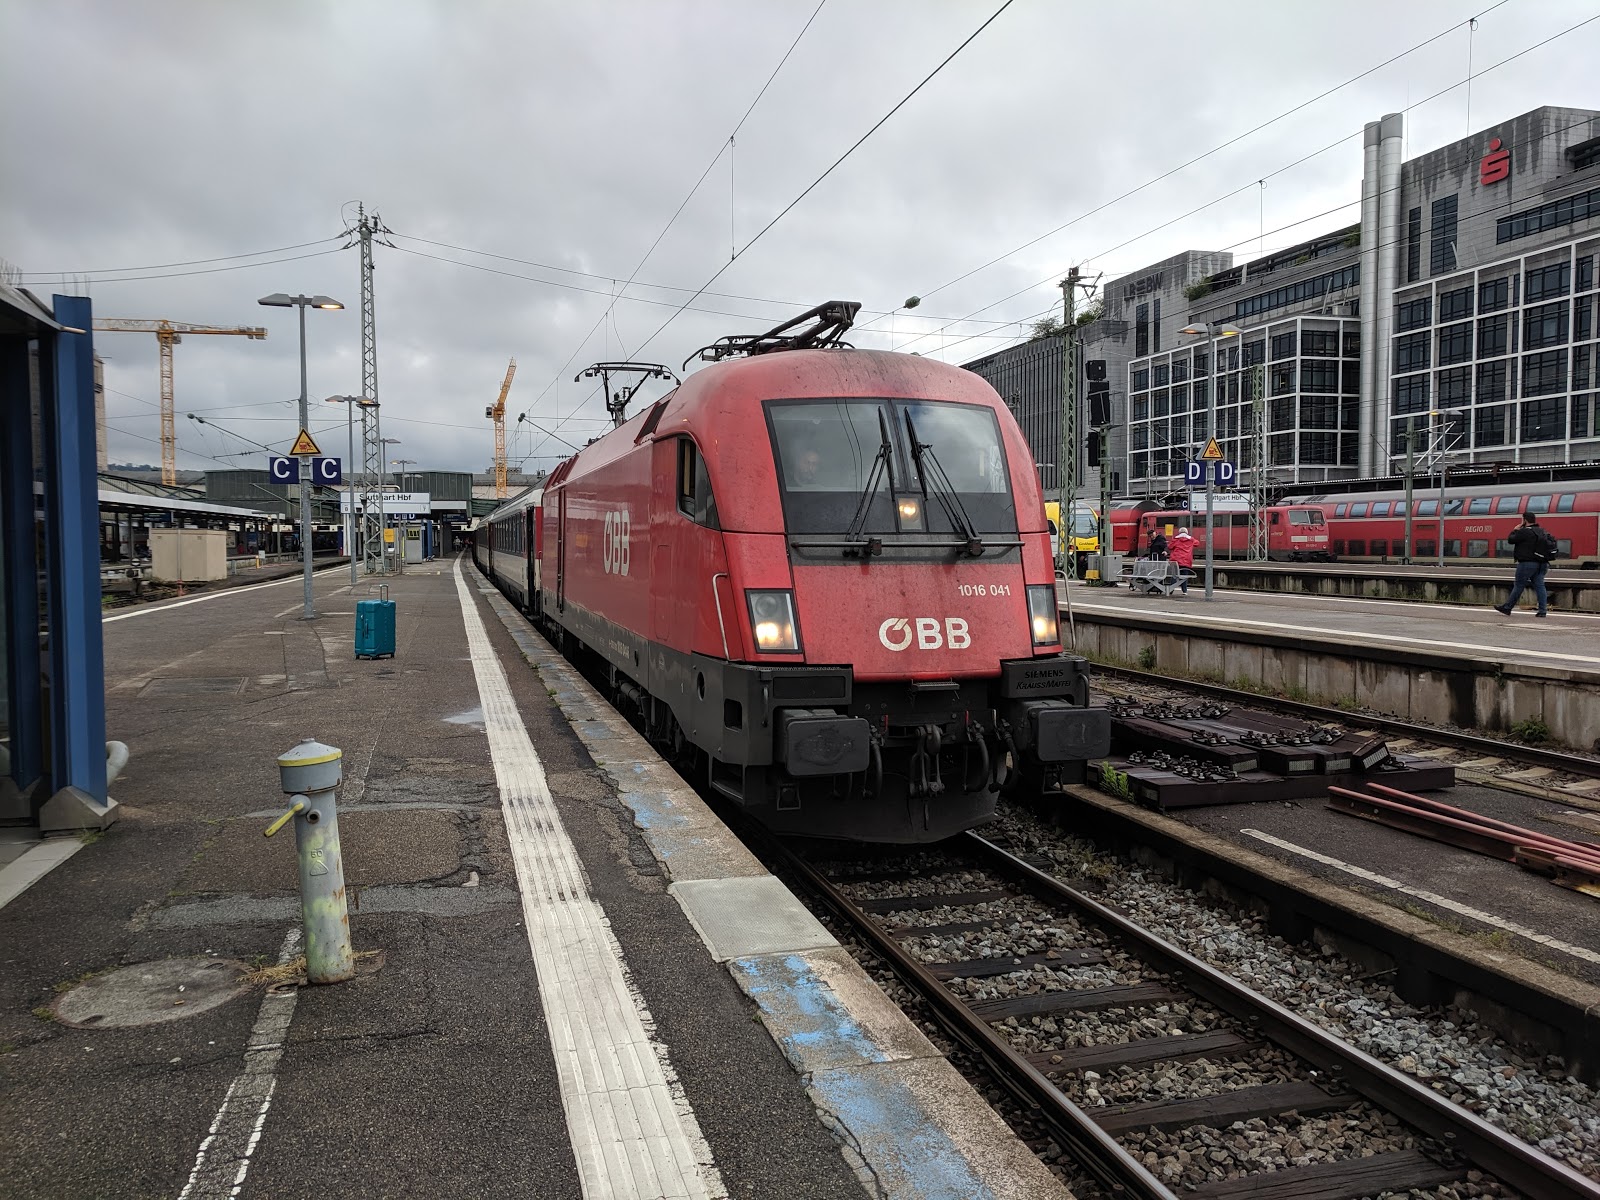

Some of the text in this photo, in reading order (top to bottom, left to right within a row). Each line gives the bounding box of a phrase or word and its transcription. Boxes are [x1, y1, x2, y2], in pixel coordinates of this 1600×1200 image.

[273, 458, 290, 478] C
[321, 458, 338, 479] C
[1188, 462, 1201, 480] D
[1221, 462, 1233, 480] D
[1182, 500, 1188, 508] C
[1464, 525, 1484, 533] REGIO
[603, 510, 630, 577] ÖBB
[957, 584, 1011, 597] 1016 041
[878, 616, 972, 652] ÖBB
[1024, 669, 1064, 679] SIEMENS
